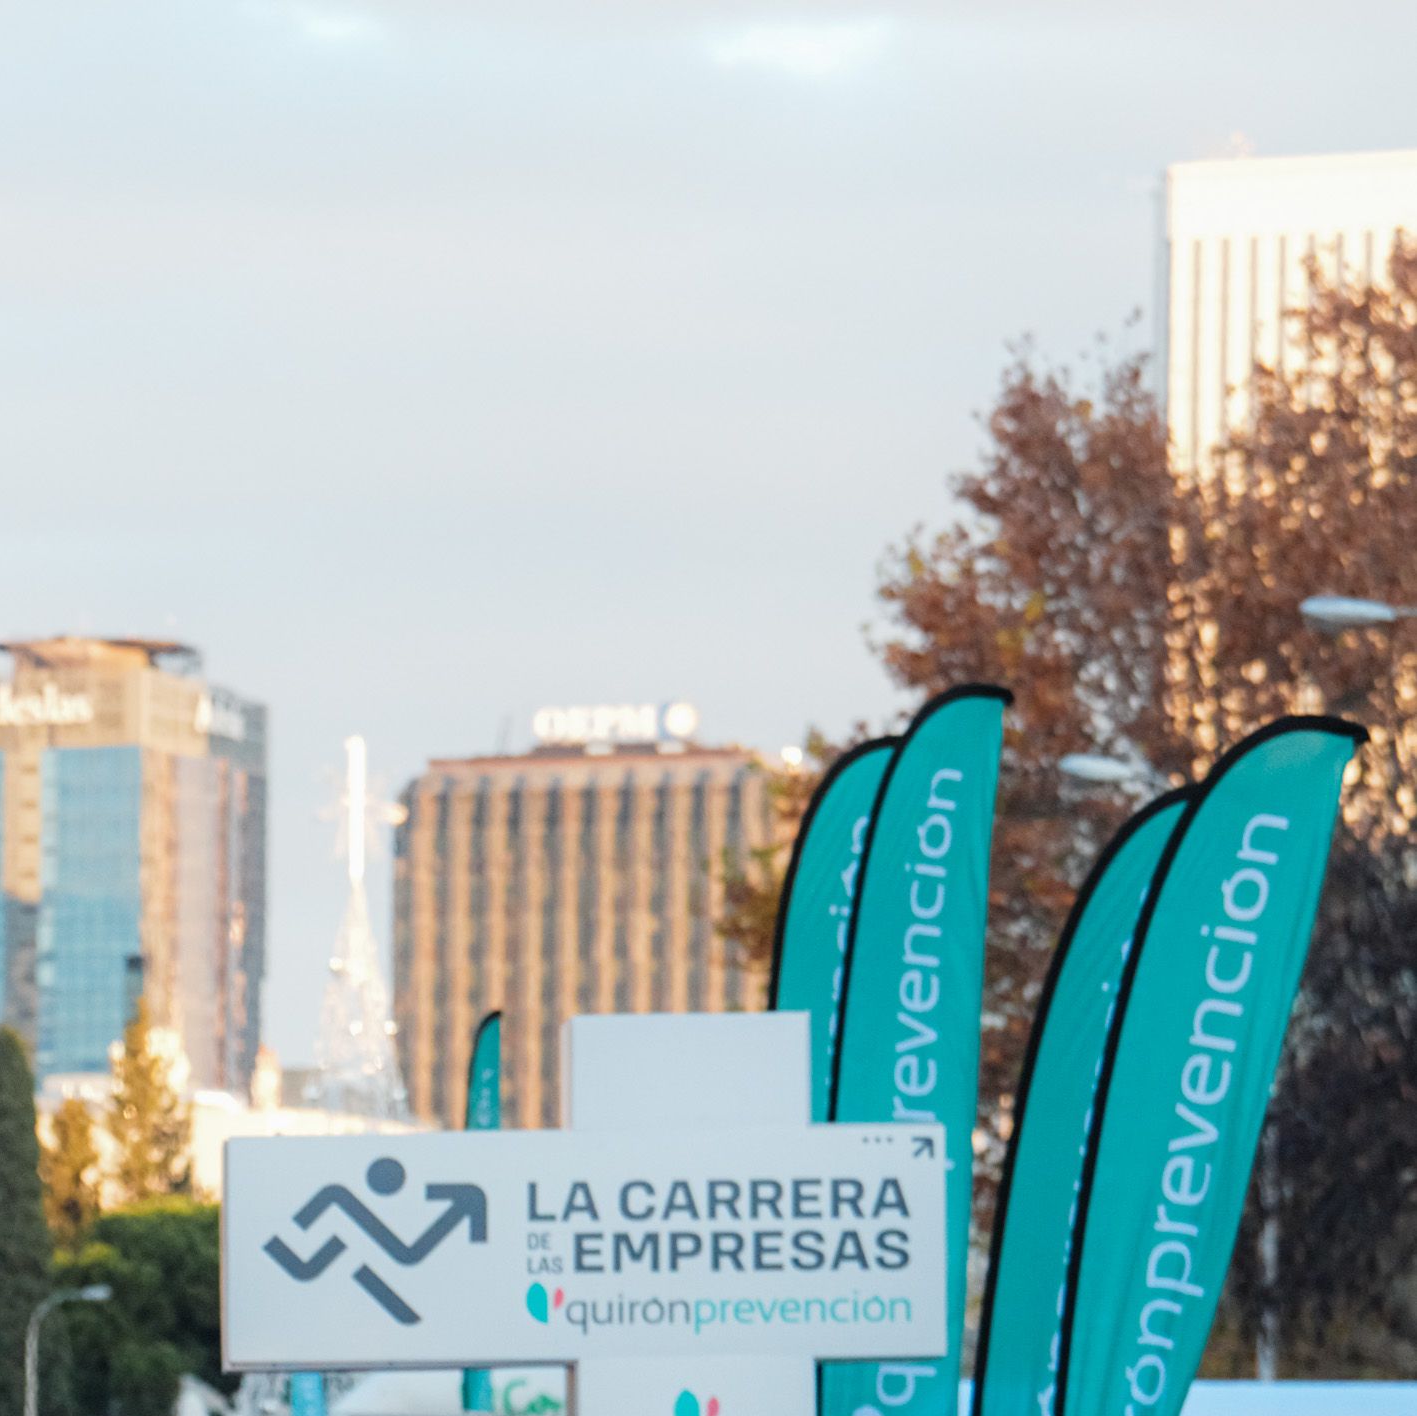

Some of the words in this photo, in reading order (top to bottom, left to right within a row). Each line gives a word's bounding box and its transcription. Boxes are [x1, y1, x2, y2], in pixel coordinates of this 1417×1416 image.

[527, 1180, 600, 1222] LA
[618, 1176, 911, 1222] CARRERA
[527, 1232, 552, 1250] DE
[573, 1227, 911, 1274] EMPRESAS
[527, 1256, 564, 1274] LAS
[564, 1288, 913, 1335] quirónprevención
